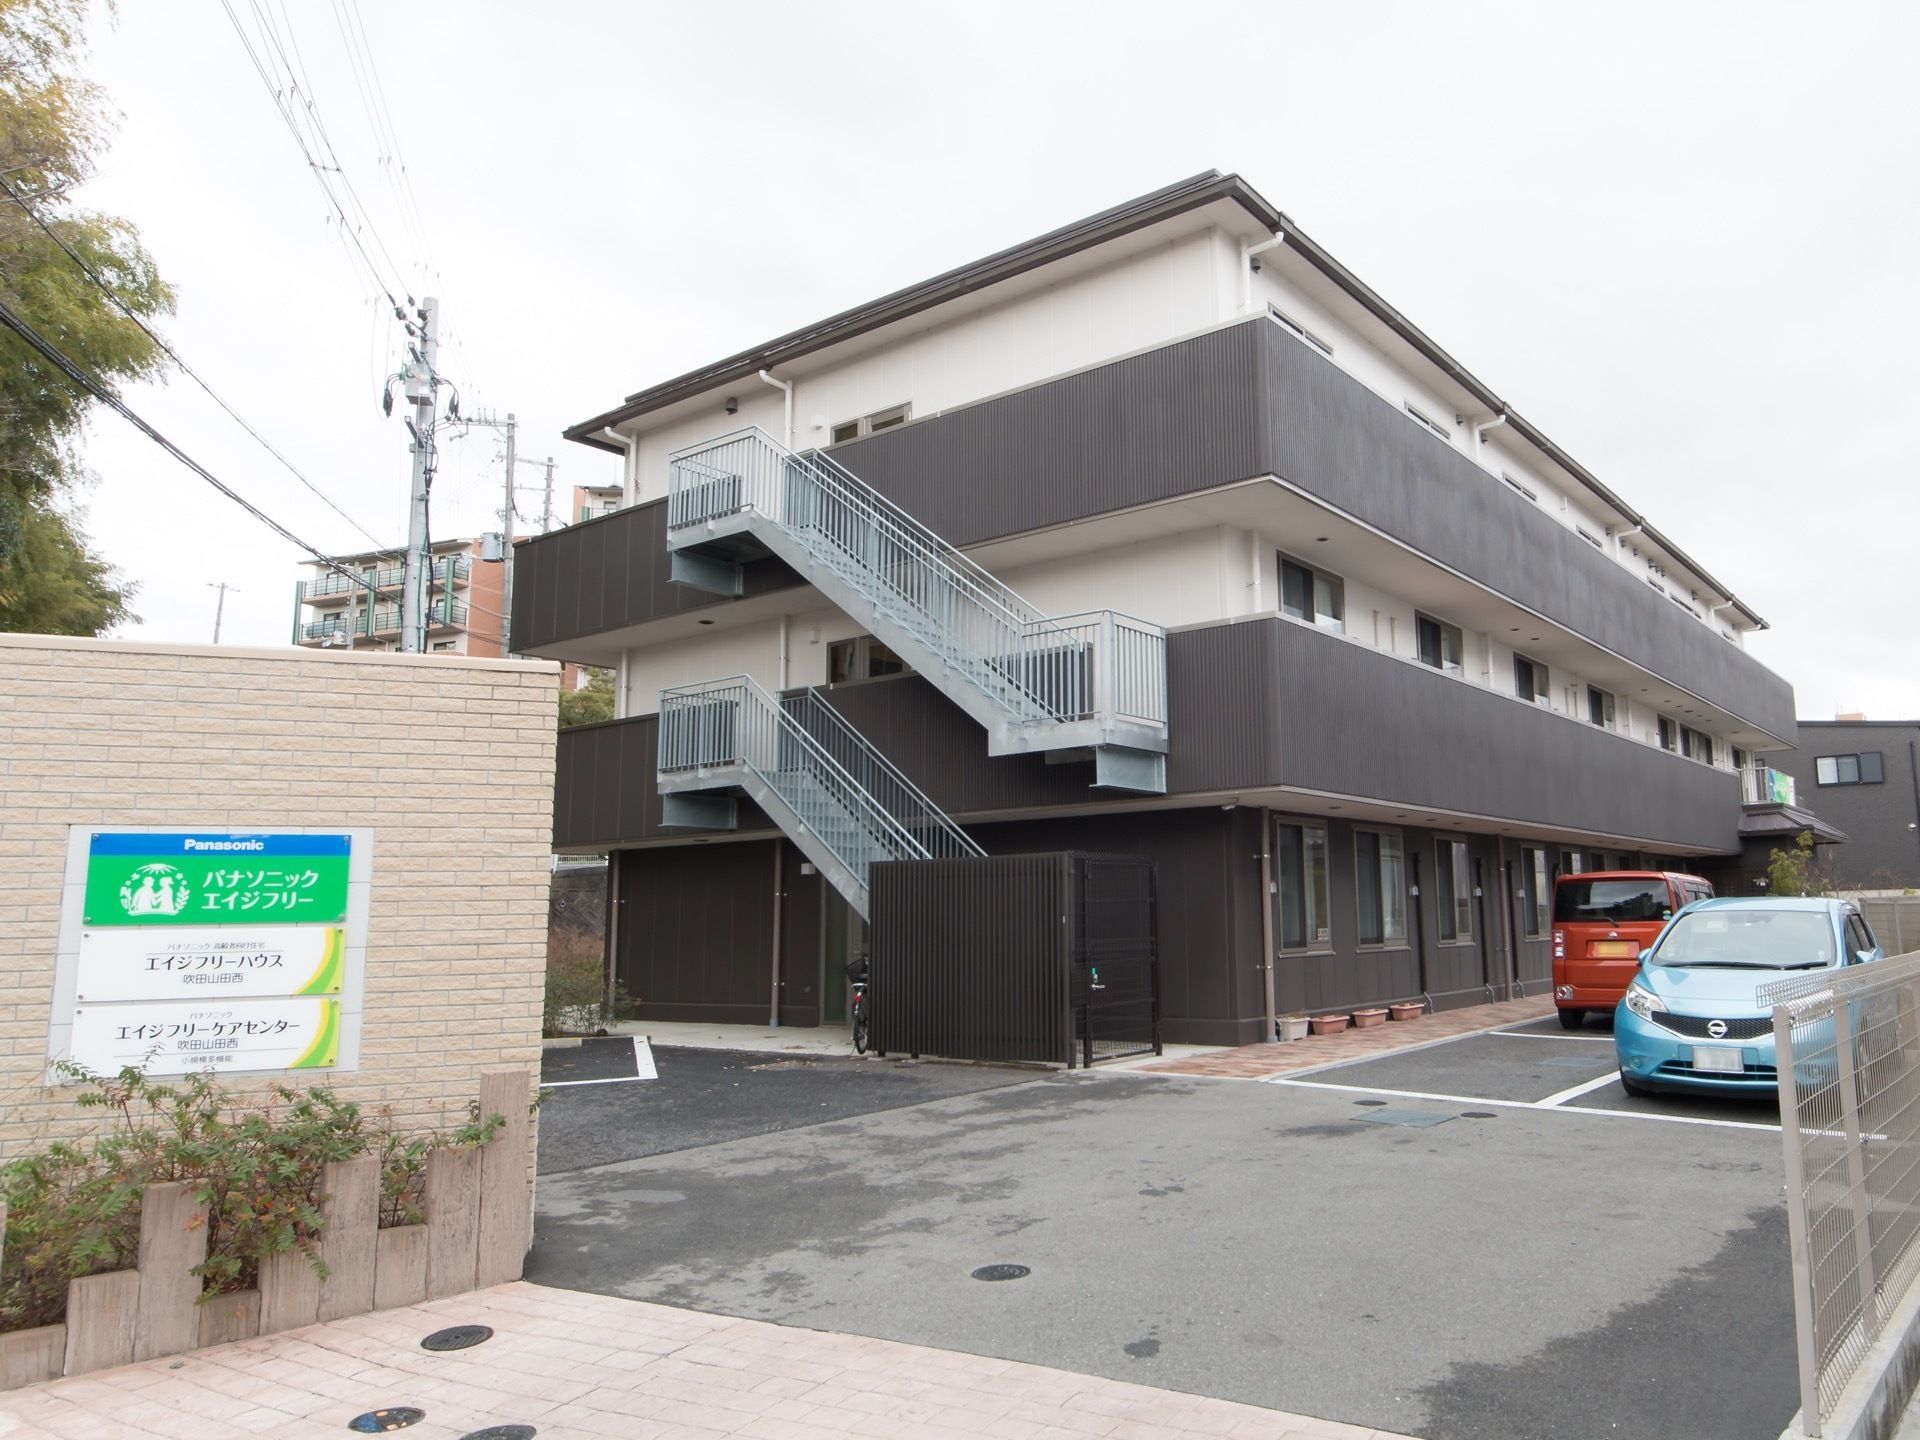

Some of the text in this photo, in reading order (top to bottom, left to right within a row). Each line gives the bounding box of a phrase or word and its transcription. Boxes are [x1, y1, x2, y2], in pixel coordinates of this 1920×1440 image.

[184, 839, 264, 851] Panasonic
[202, 869, 319, 888] パナソニック
[201, 891, 314, 910] エイジフリー
[144, 953, 284, 971] エイジフリーハウス
[183, 973, 245, 984] 吹田山田西
[115, 1019, 300, 1040] エイジフリーケアセンター
[177, 1038, 239, 1050] 吹田山田西
